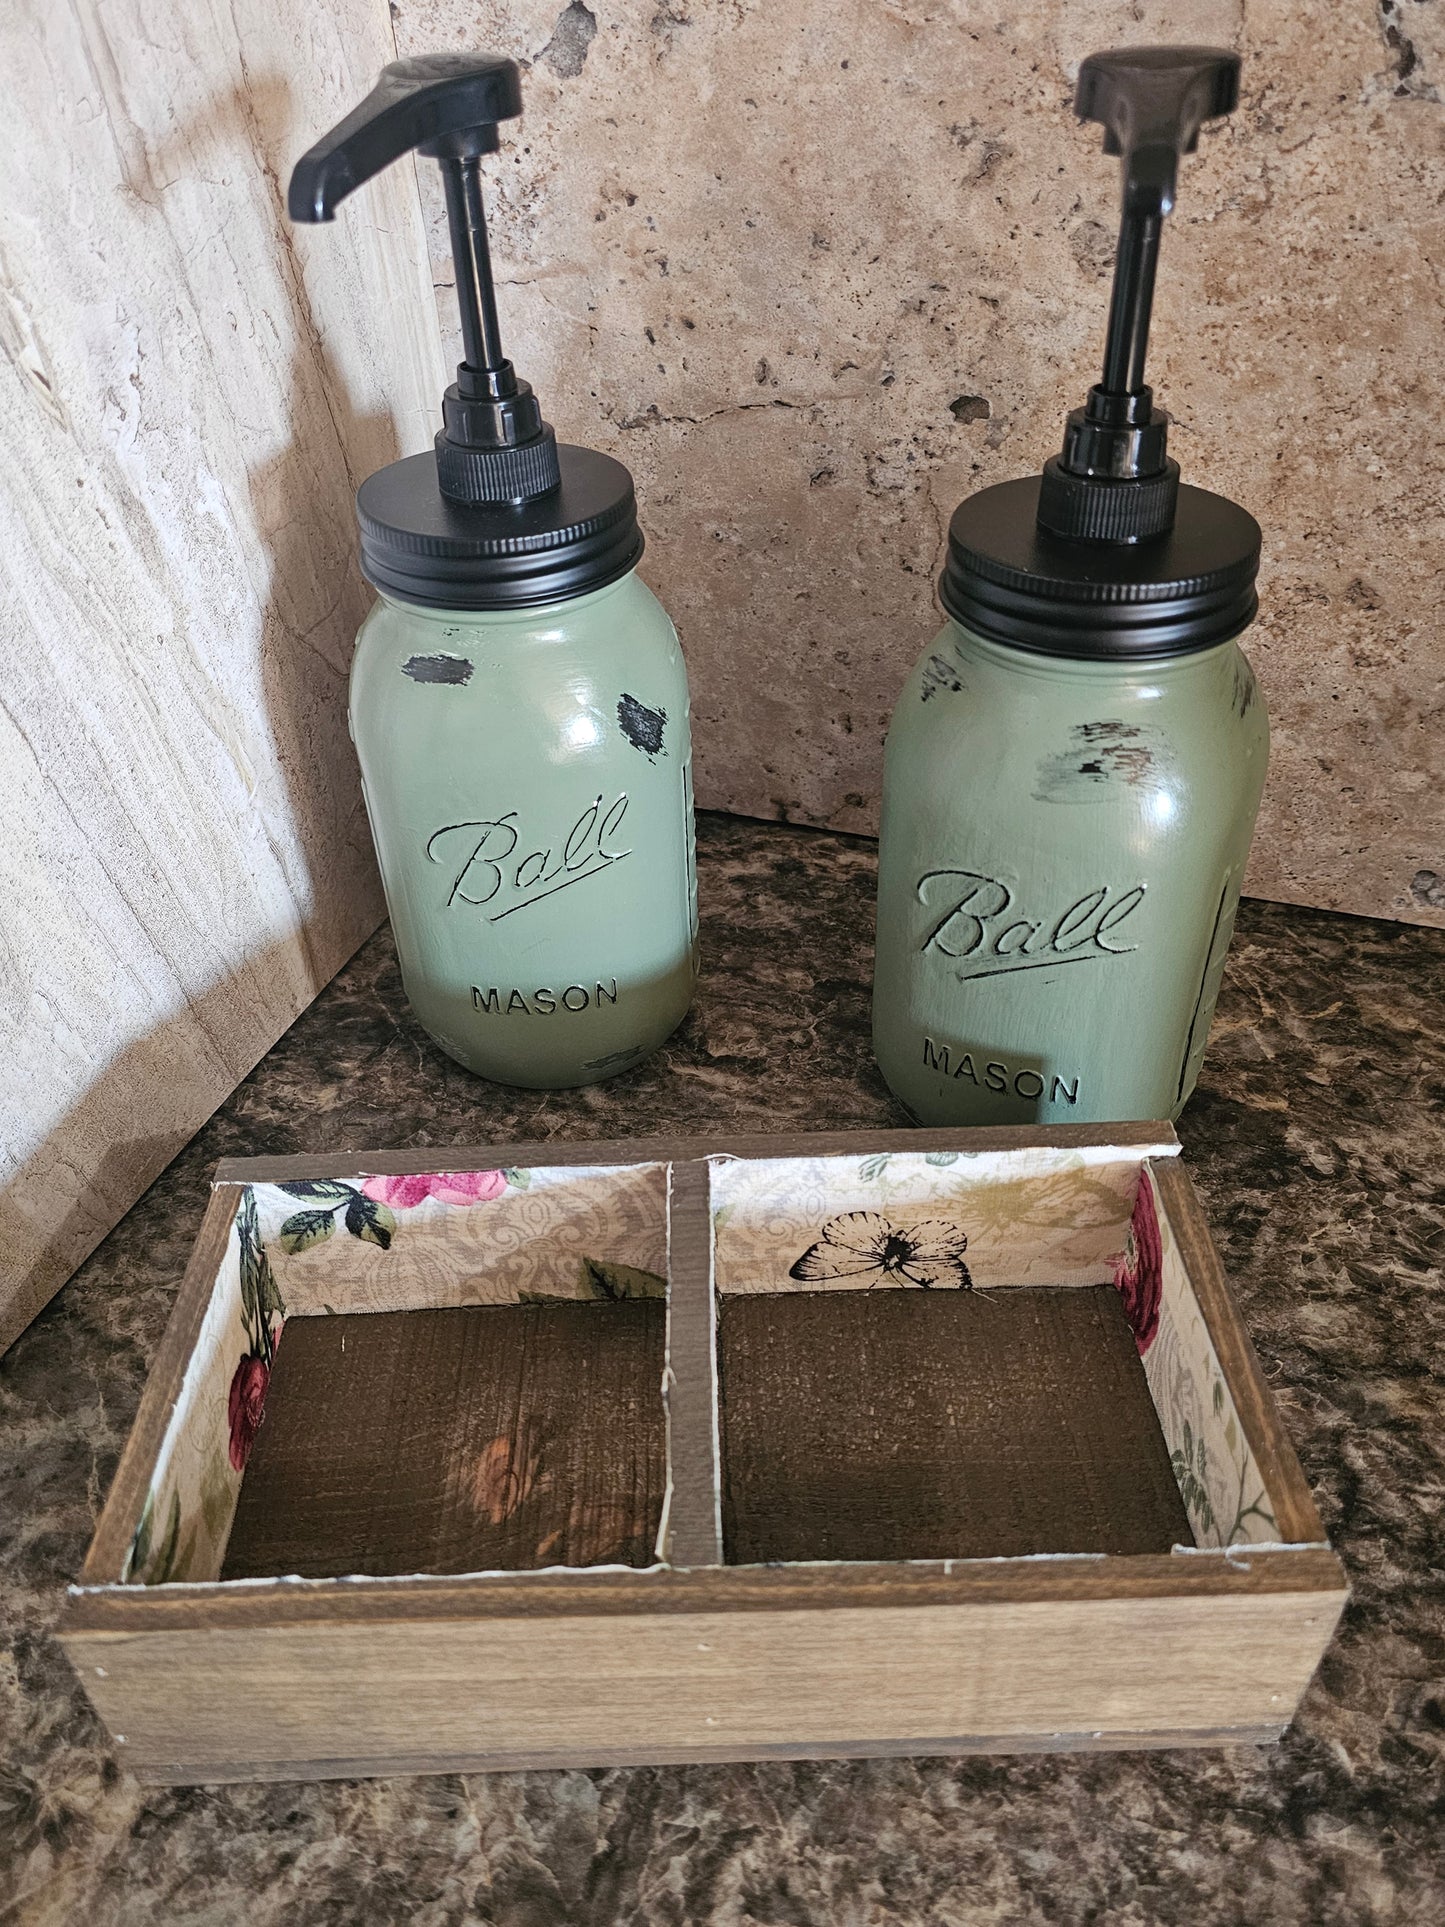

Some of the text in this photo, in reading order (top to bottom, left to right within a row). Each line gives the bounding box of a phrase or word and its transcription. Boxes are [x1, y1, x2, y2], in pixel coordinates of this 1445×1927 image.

[426, 792, 632, 907] Ball
[916, 868, 1148, 957] Ball
[471, 978, 618, 1015] MASON
[922, 1036, 1080, 1105] MASON
